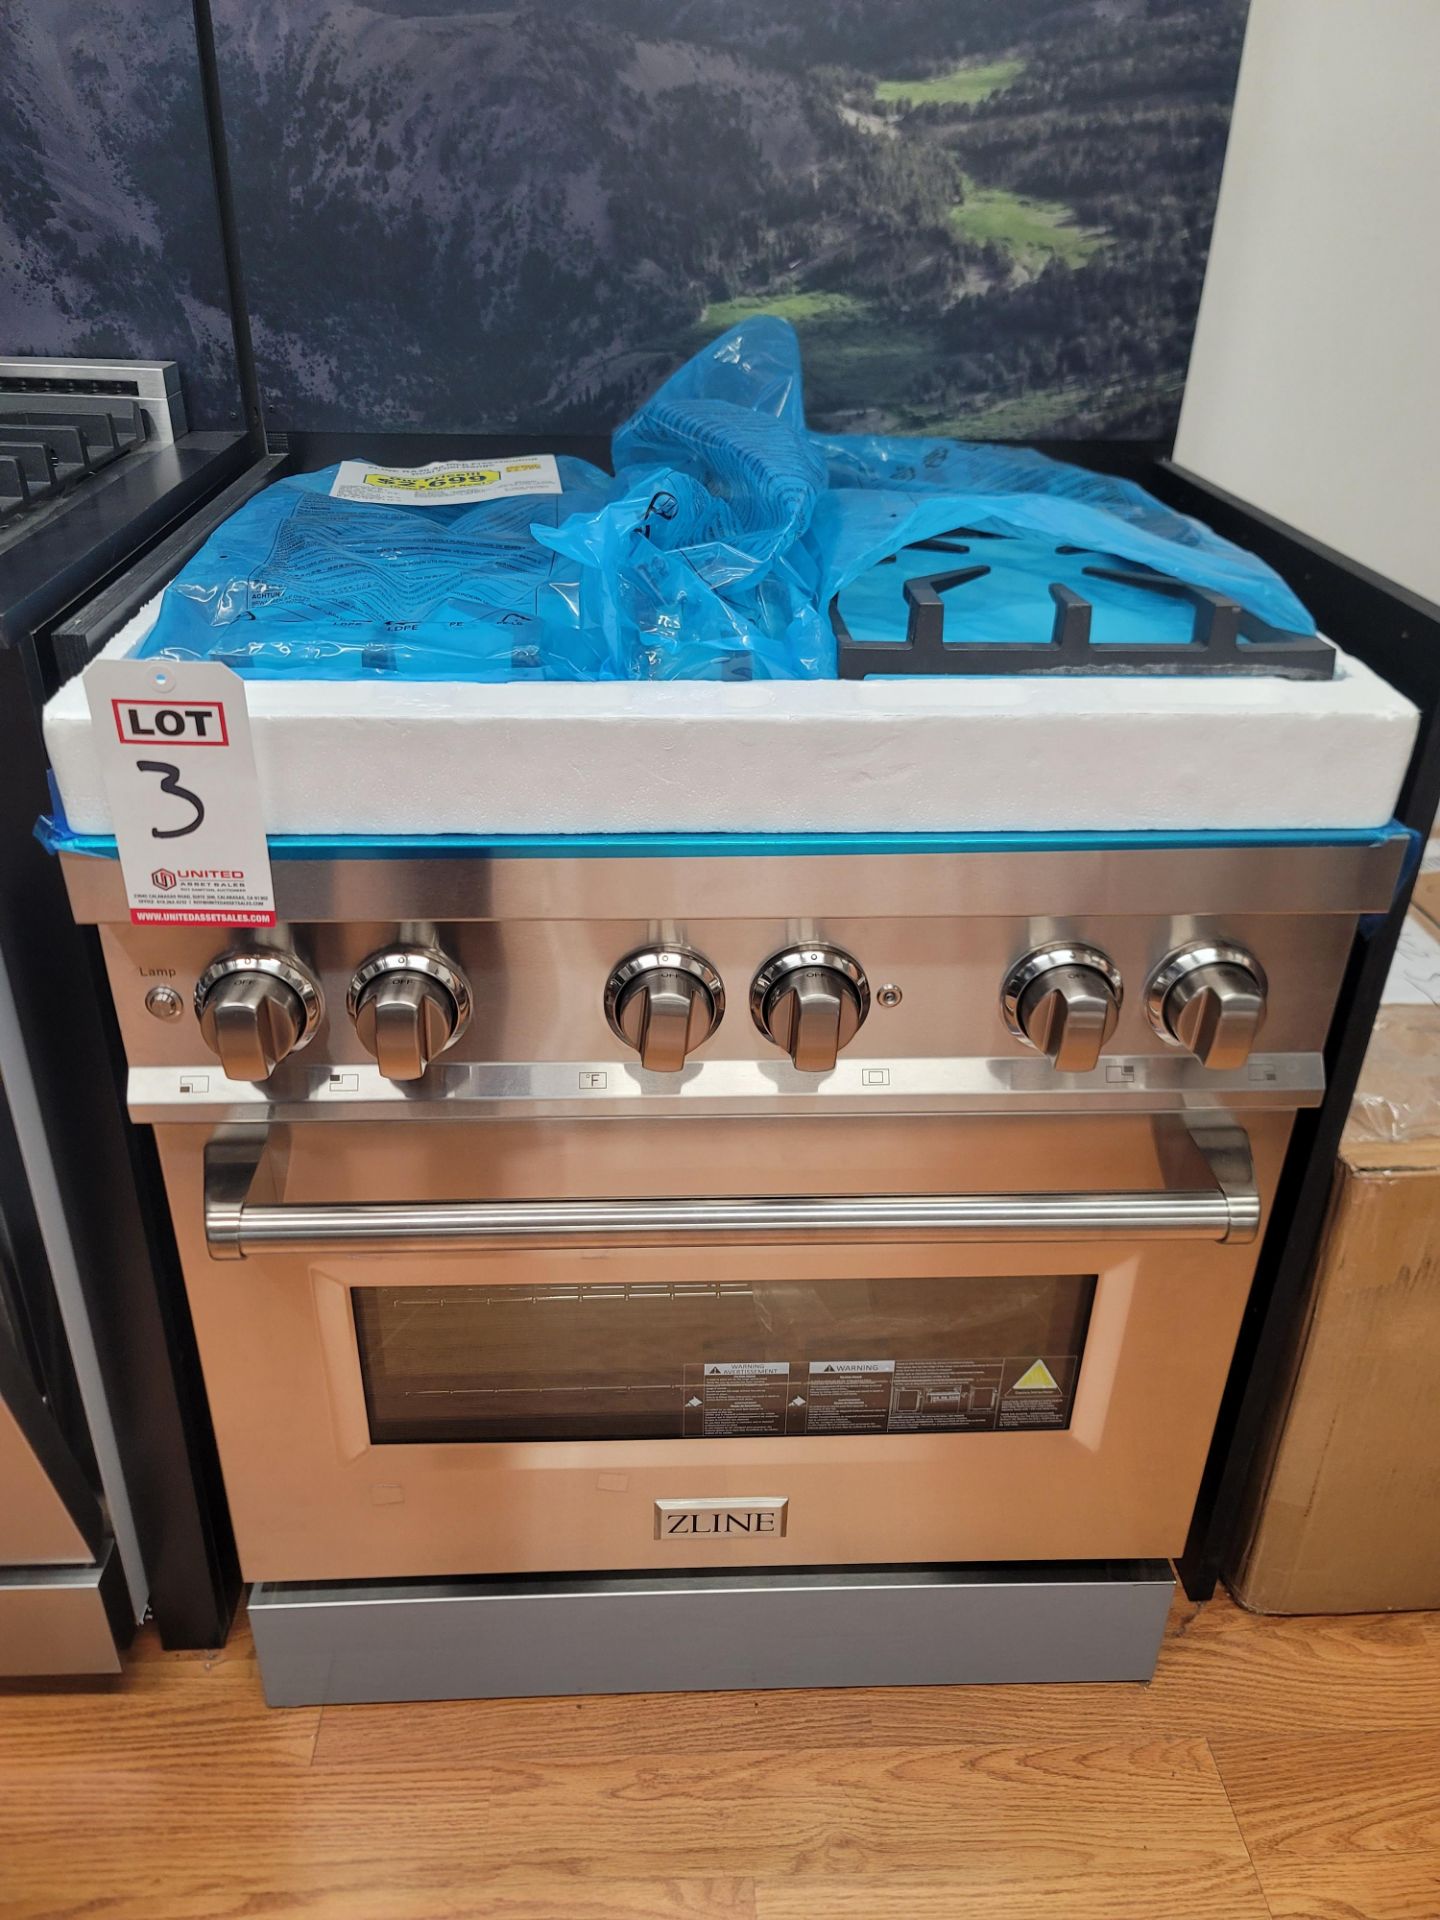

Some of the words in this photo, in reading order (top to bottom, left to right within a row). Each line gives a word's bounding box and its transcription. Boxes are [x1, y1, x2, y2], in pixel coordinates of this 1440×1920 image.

[377, 475, 487, 489] $2,699
[128, 709, 212, 737] LOT
[136, 760, 205, 839] 3
[177, 870, 244, 879] UNITED
[136, 912, 270, 923] WWW.UNITEDASSETSALES.COM
[139, 967, 176, 978] Lamp
[392, 978, 414, 986] OFF
[836, 1364, 879, 1372] WARNING
[667, 1512, 775, 1534] ZLINE
